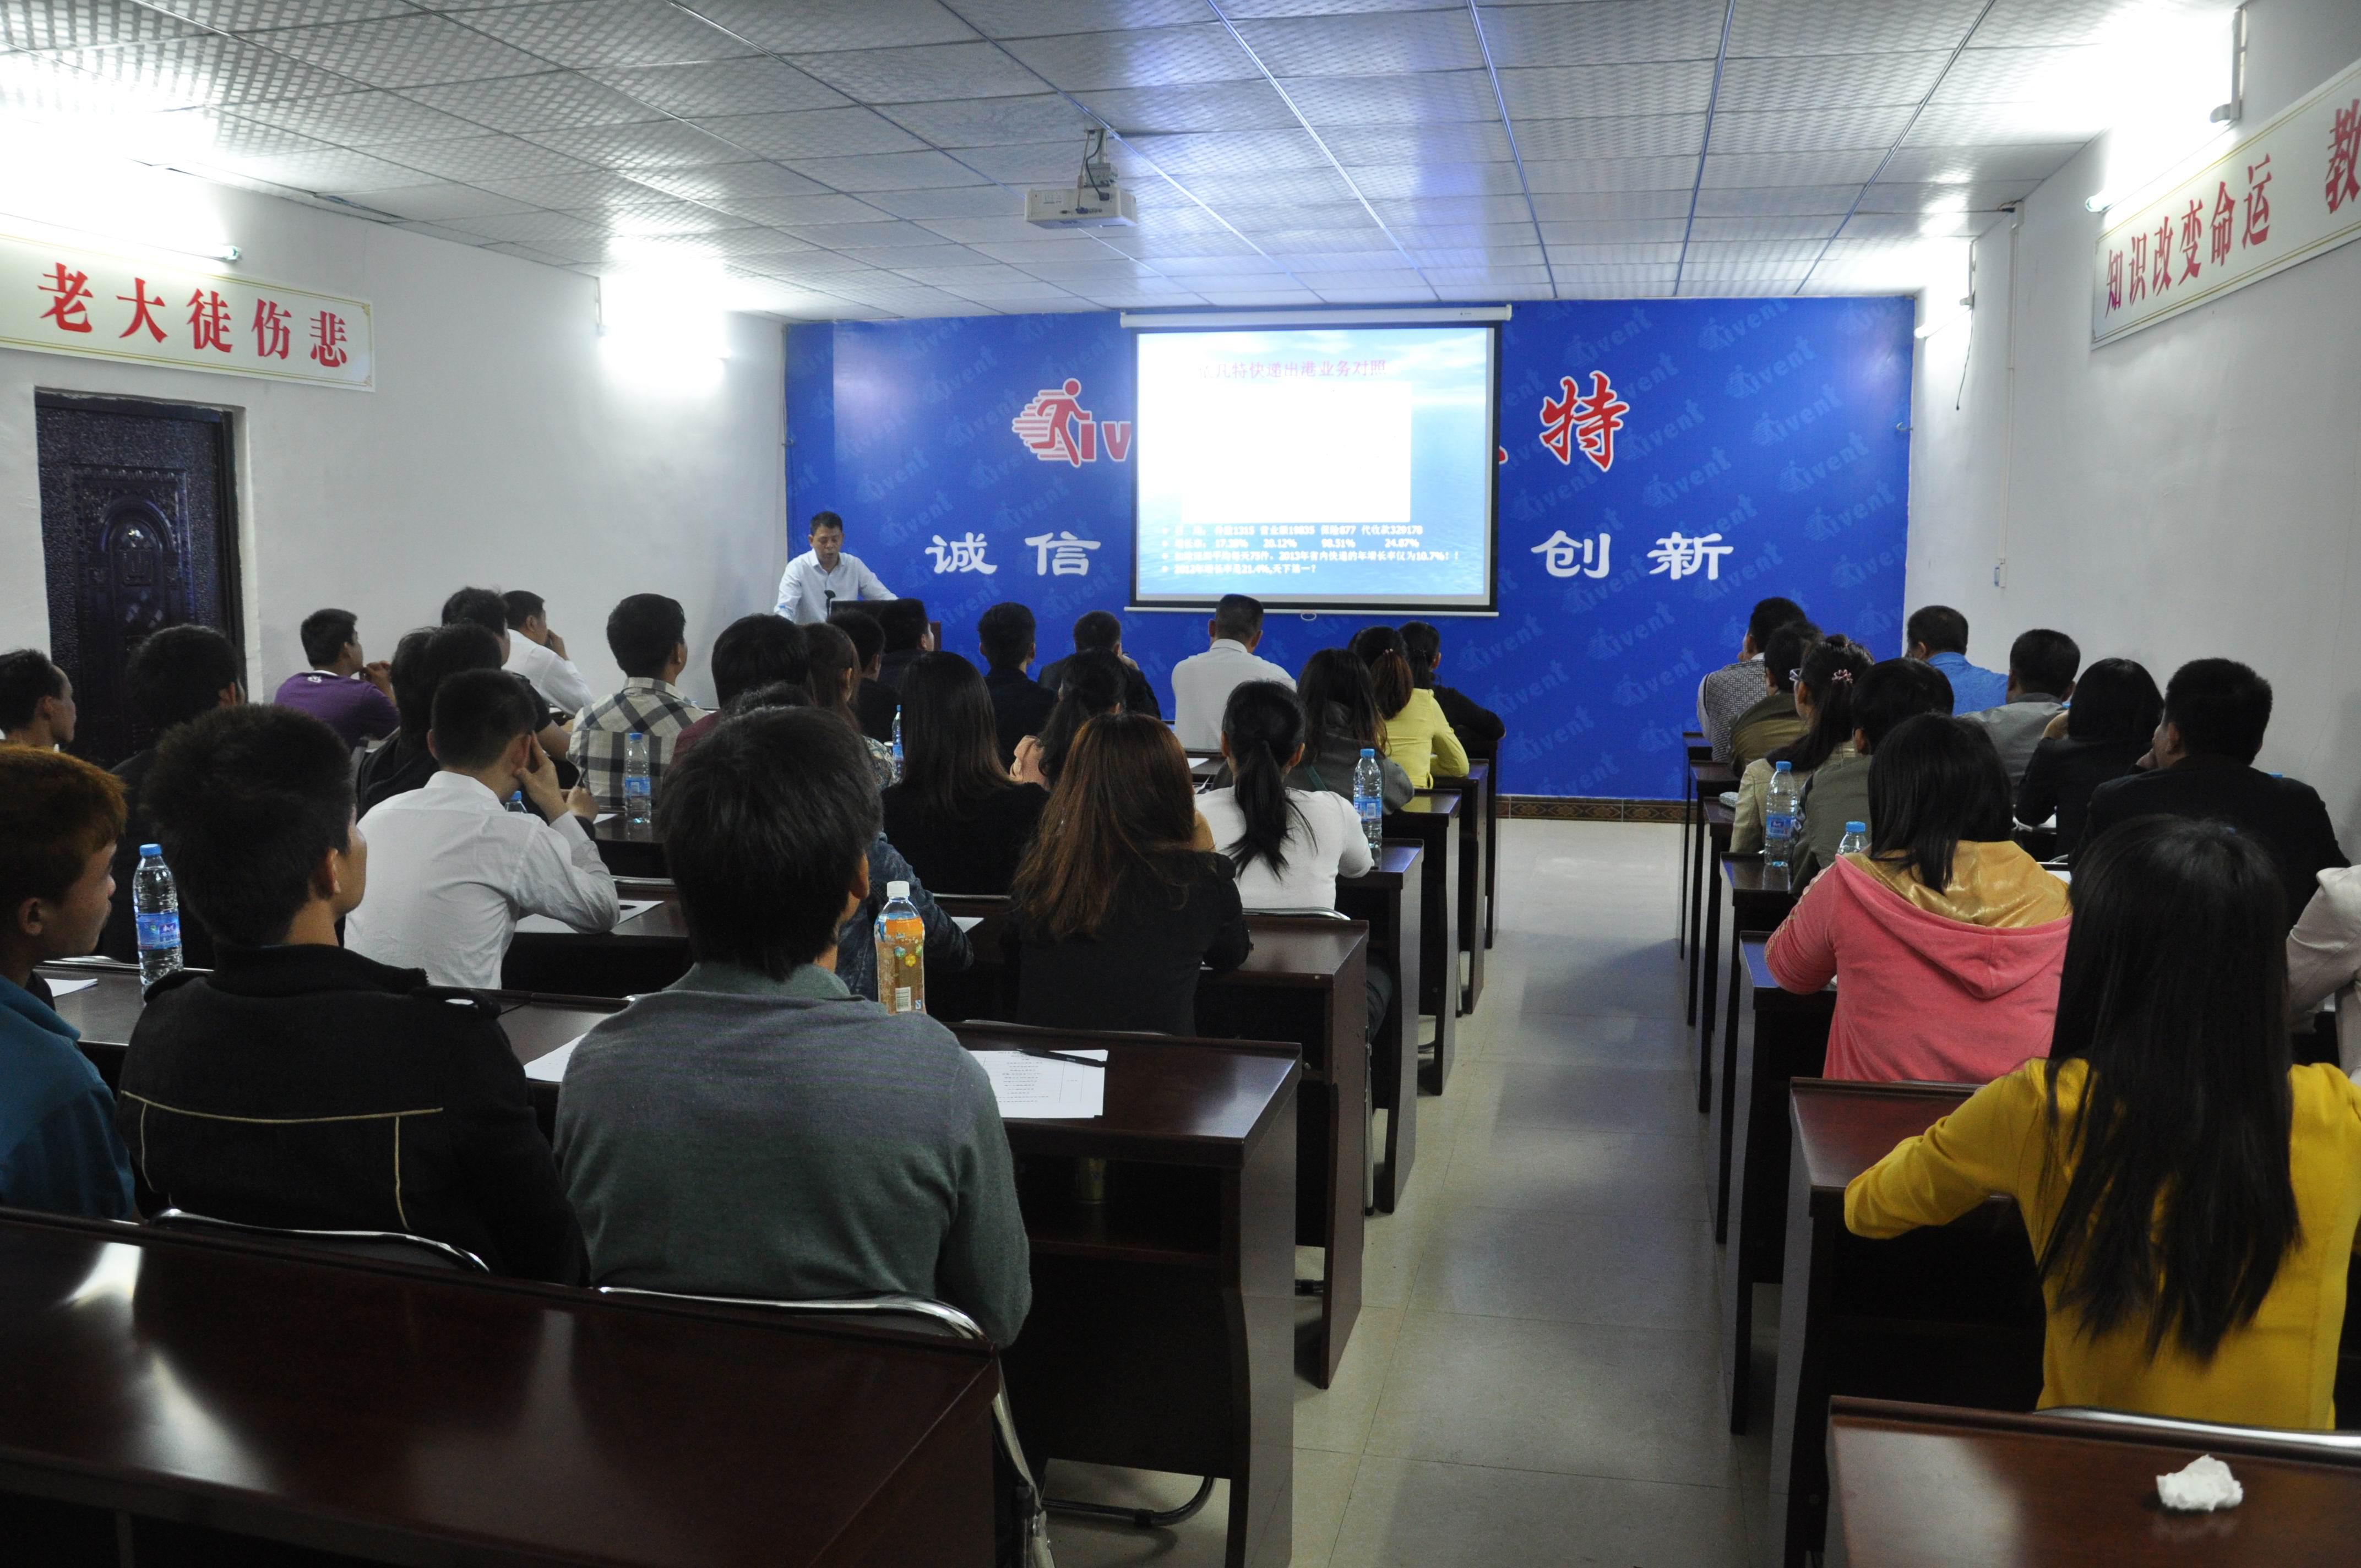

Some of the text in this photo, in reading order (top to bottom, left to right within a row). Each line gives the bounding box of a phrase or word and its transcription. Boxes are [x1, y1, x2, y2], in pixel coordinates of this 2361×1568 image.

[2105, 153, 2273, 318] 知识改变命运
[37, 263, 347, 367] 老大徒伤悲
[1539, 369, 1630, 473] 特
[923, 529, 1734, 580] 诚信 创新
